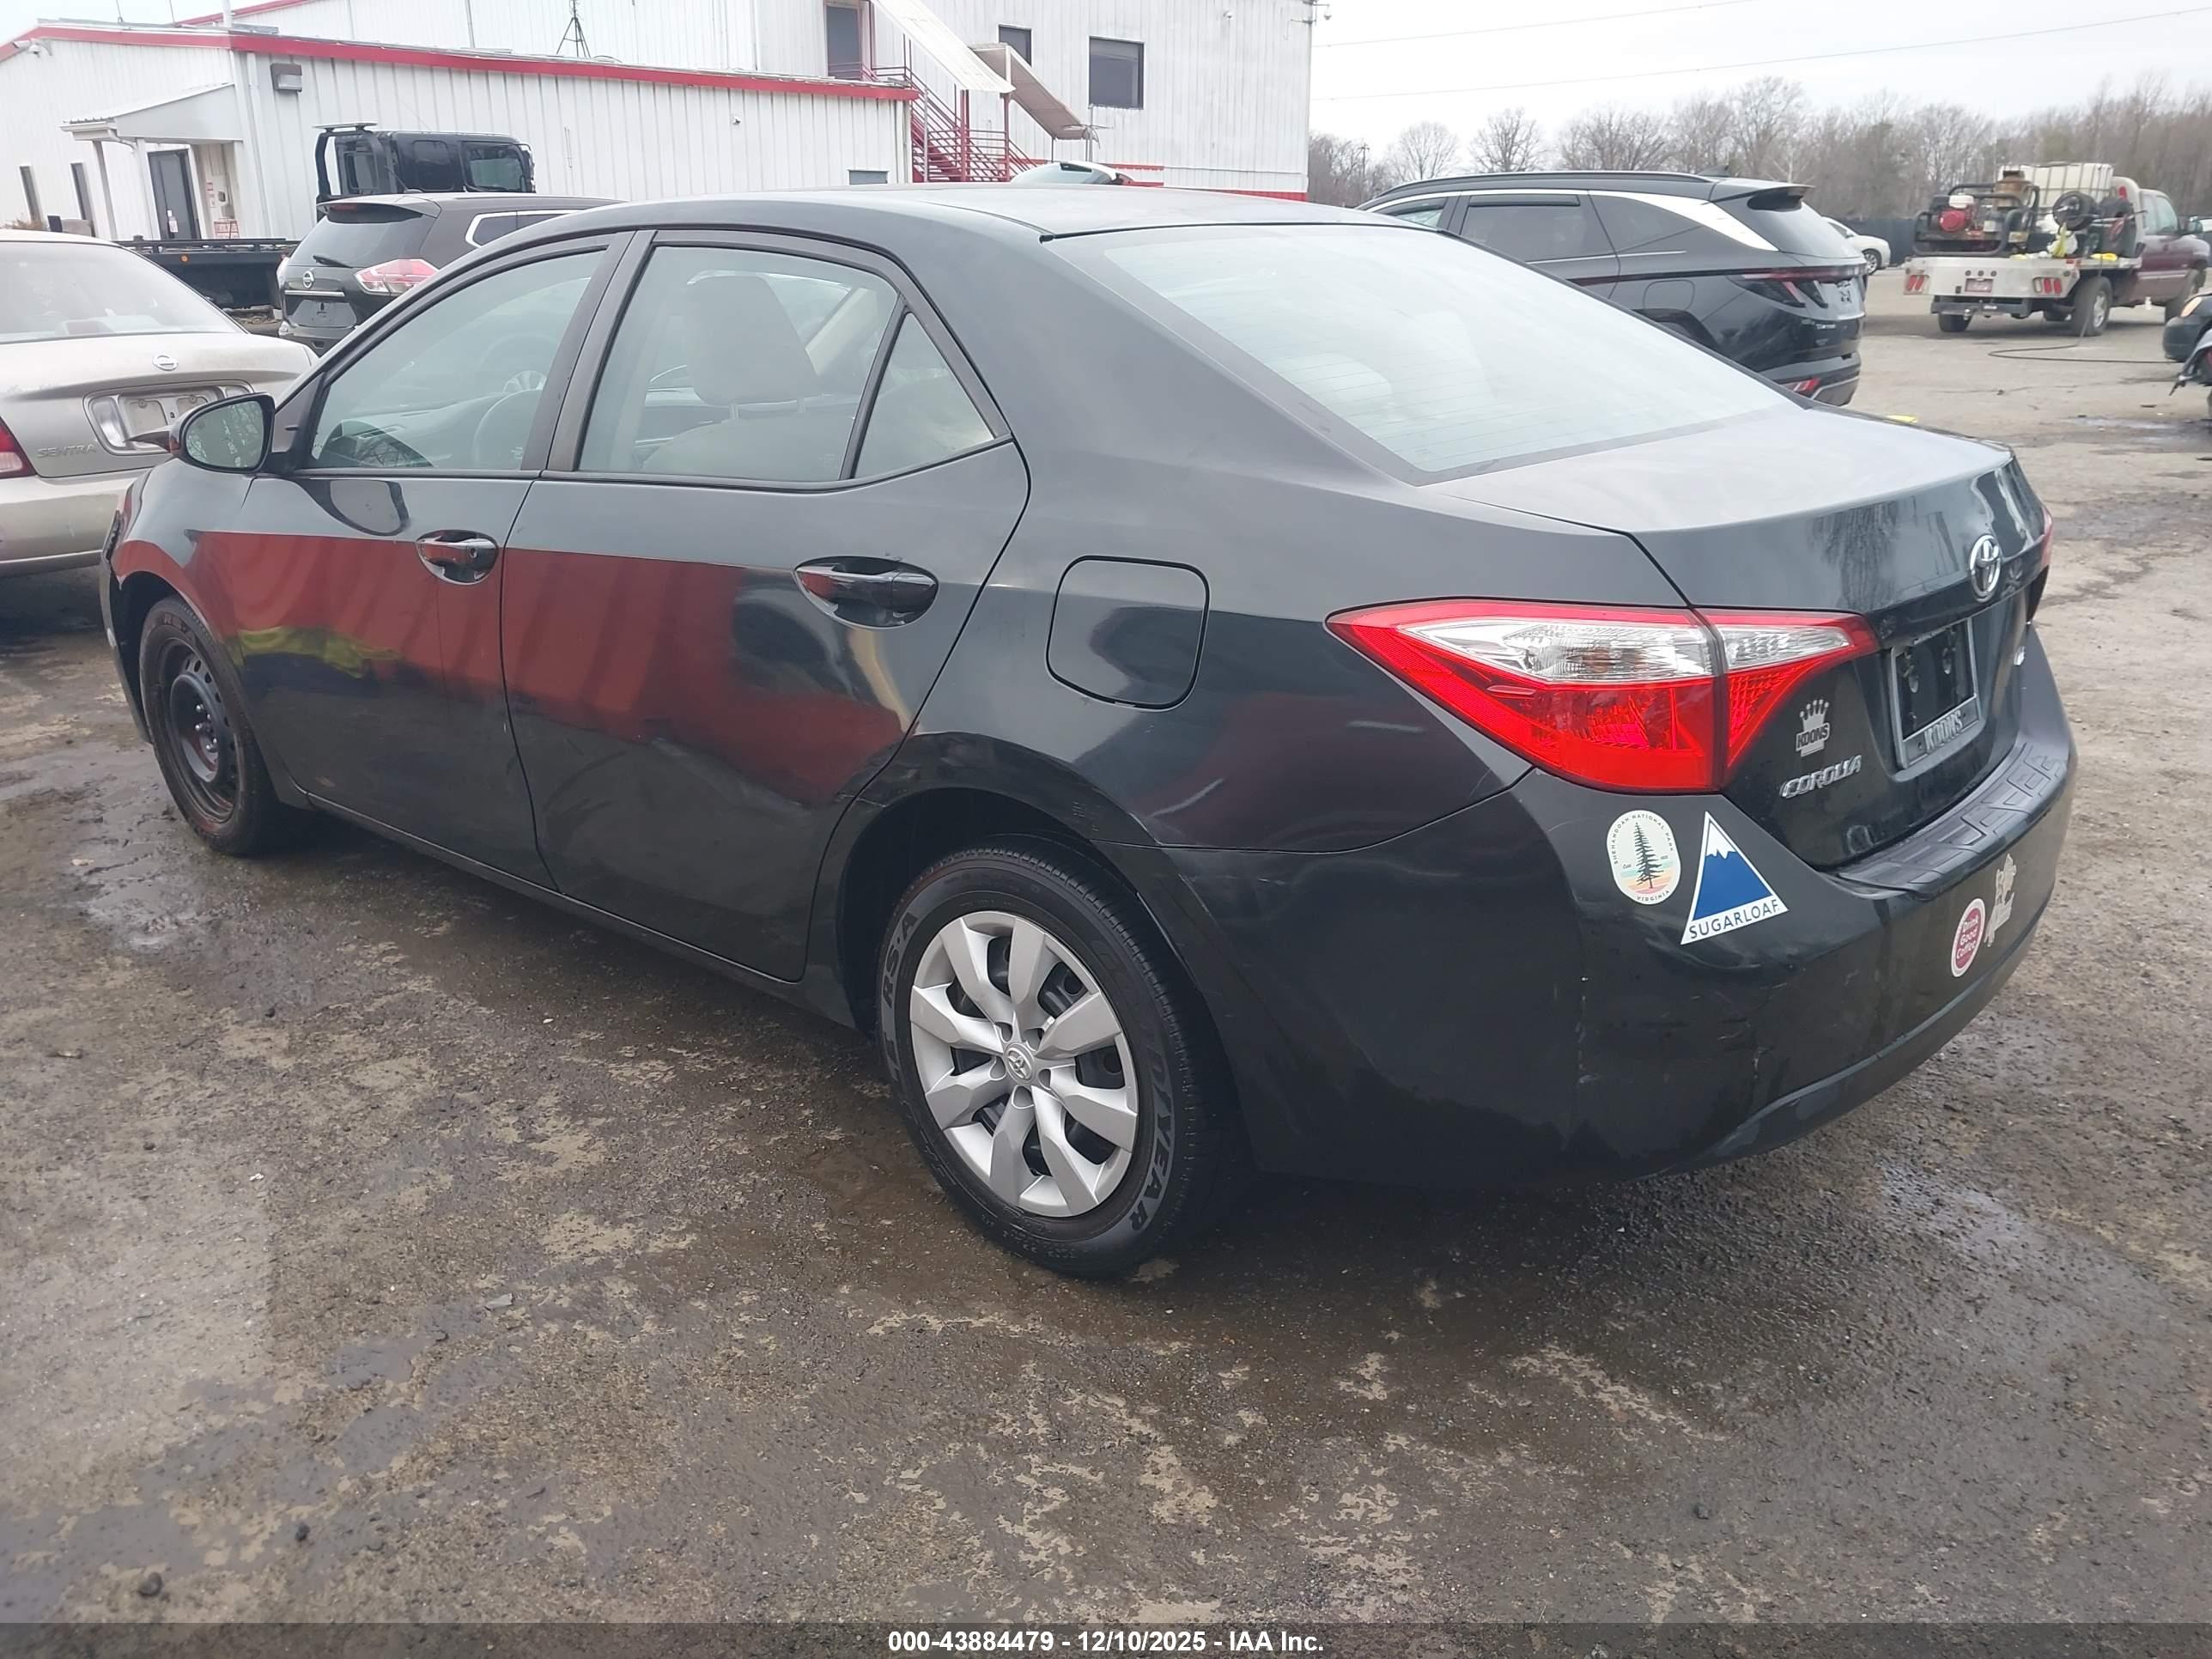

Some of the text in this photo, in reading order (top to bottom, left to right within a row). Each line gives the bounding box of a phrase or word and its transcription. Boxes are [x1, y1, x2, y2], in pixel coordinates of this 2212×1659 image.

[35, 443, 97, 459] SENTRA
[1797, 724, 1830, 750] KOONS
[1923, 709, 1964, 753] KOONS
[1779, 755, 1862, 799] COROLLA
[1632, 813, 1665, 830] NATIONAL
[1664, 832, 1674, 852] PARK
[1637, 890, 1670, 902] VIRGINIA
[1688, 898, 1780, 939] SUGARLOAF
[1963, 915, 1980, 933] Drink
[1960, 927, 1978, 946] Good
[1956, 940, 1977, 960] Coffee
